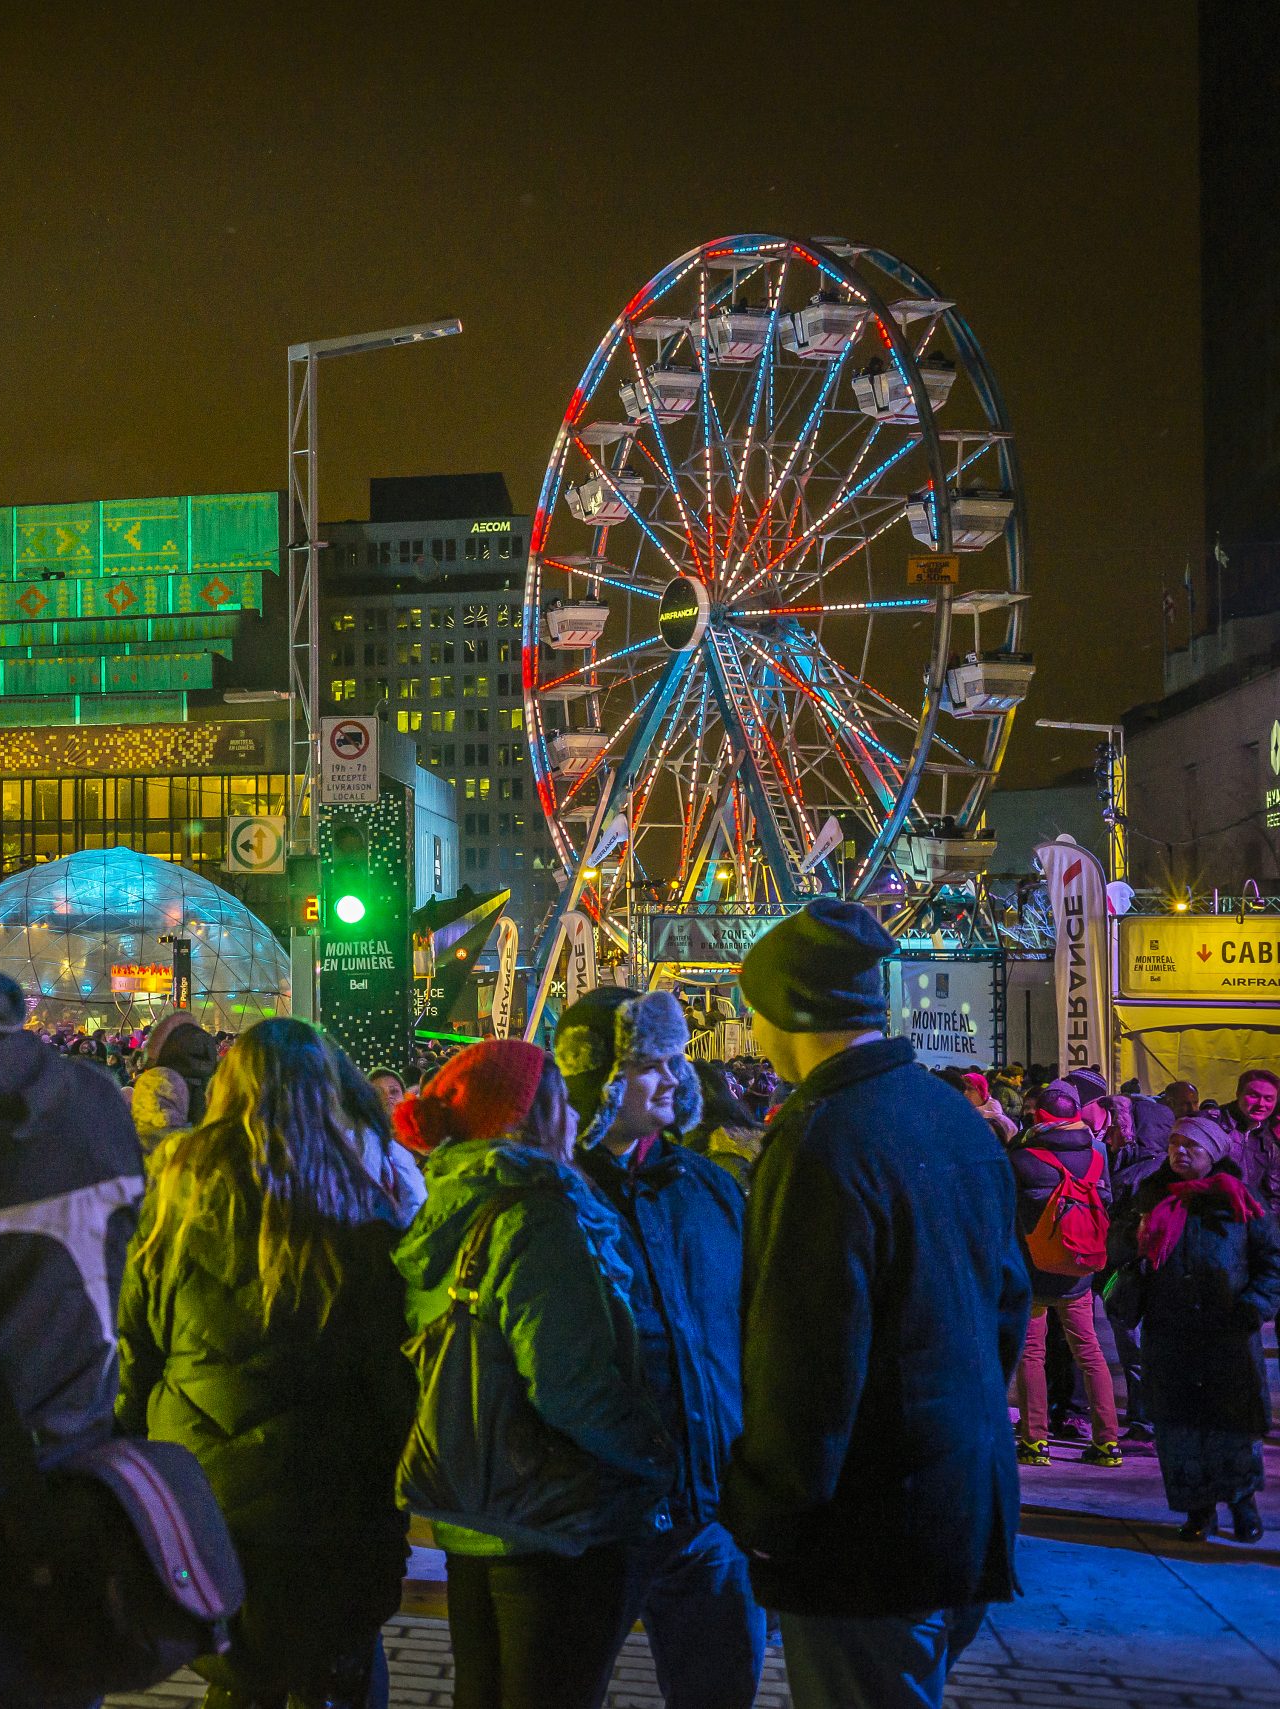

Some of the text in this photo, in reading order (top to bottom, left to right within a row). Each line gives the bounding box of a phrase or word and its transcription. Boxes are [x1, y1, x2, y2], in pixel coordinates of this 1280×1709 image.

[471, 521, 510, 533] AECOM
[659, 608, 695, 621] AIRFRANCE
[327, 783, 372, 791] LIVRAISON
[721, 929, 748, 940] ZONE
[325, 939, 392, 957] MONTRÉAL
[323, 956, 395, 972] EN LUMIÈRE
[1135, 955, 1175, 964] MONTRÉAL
[1145, 964, 1176, 972] LUMIÈRE
[349, 979, 368, 990] Bell
[1221, 978, 1280, 987] AIRFRA
[912, 1010, 974, 1033] MONTRÉAL
[910, 1032, 977, 1054] EN LUMIÈRE
